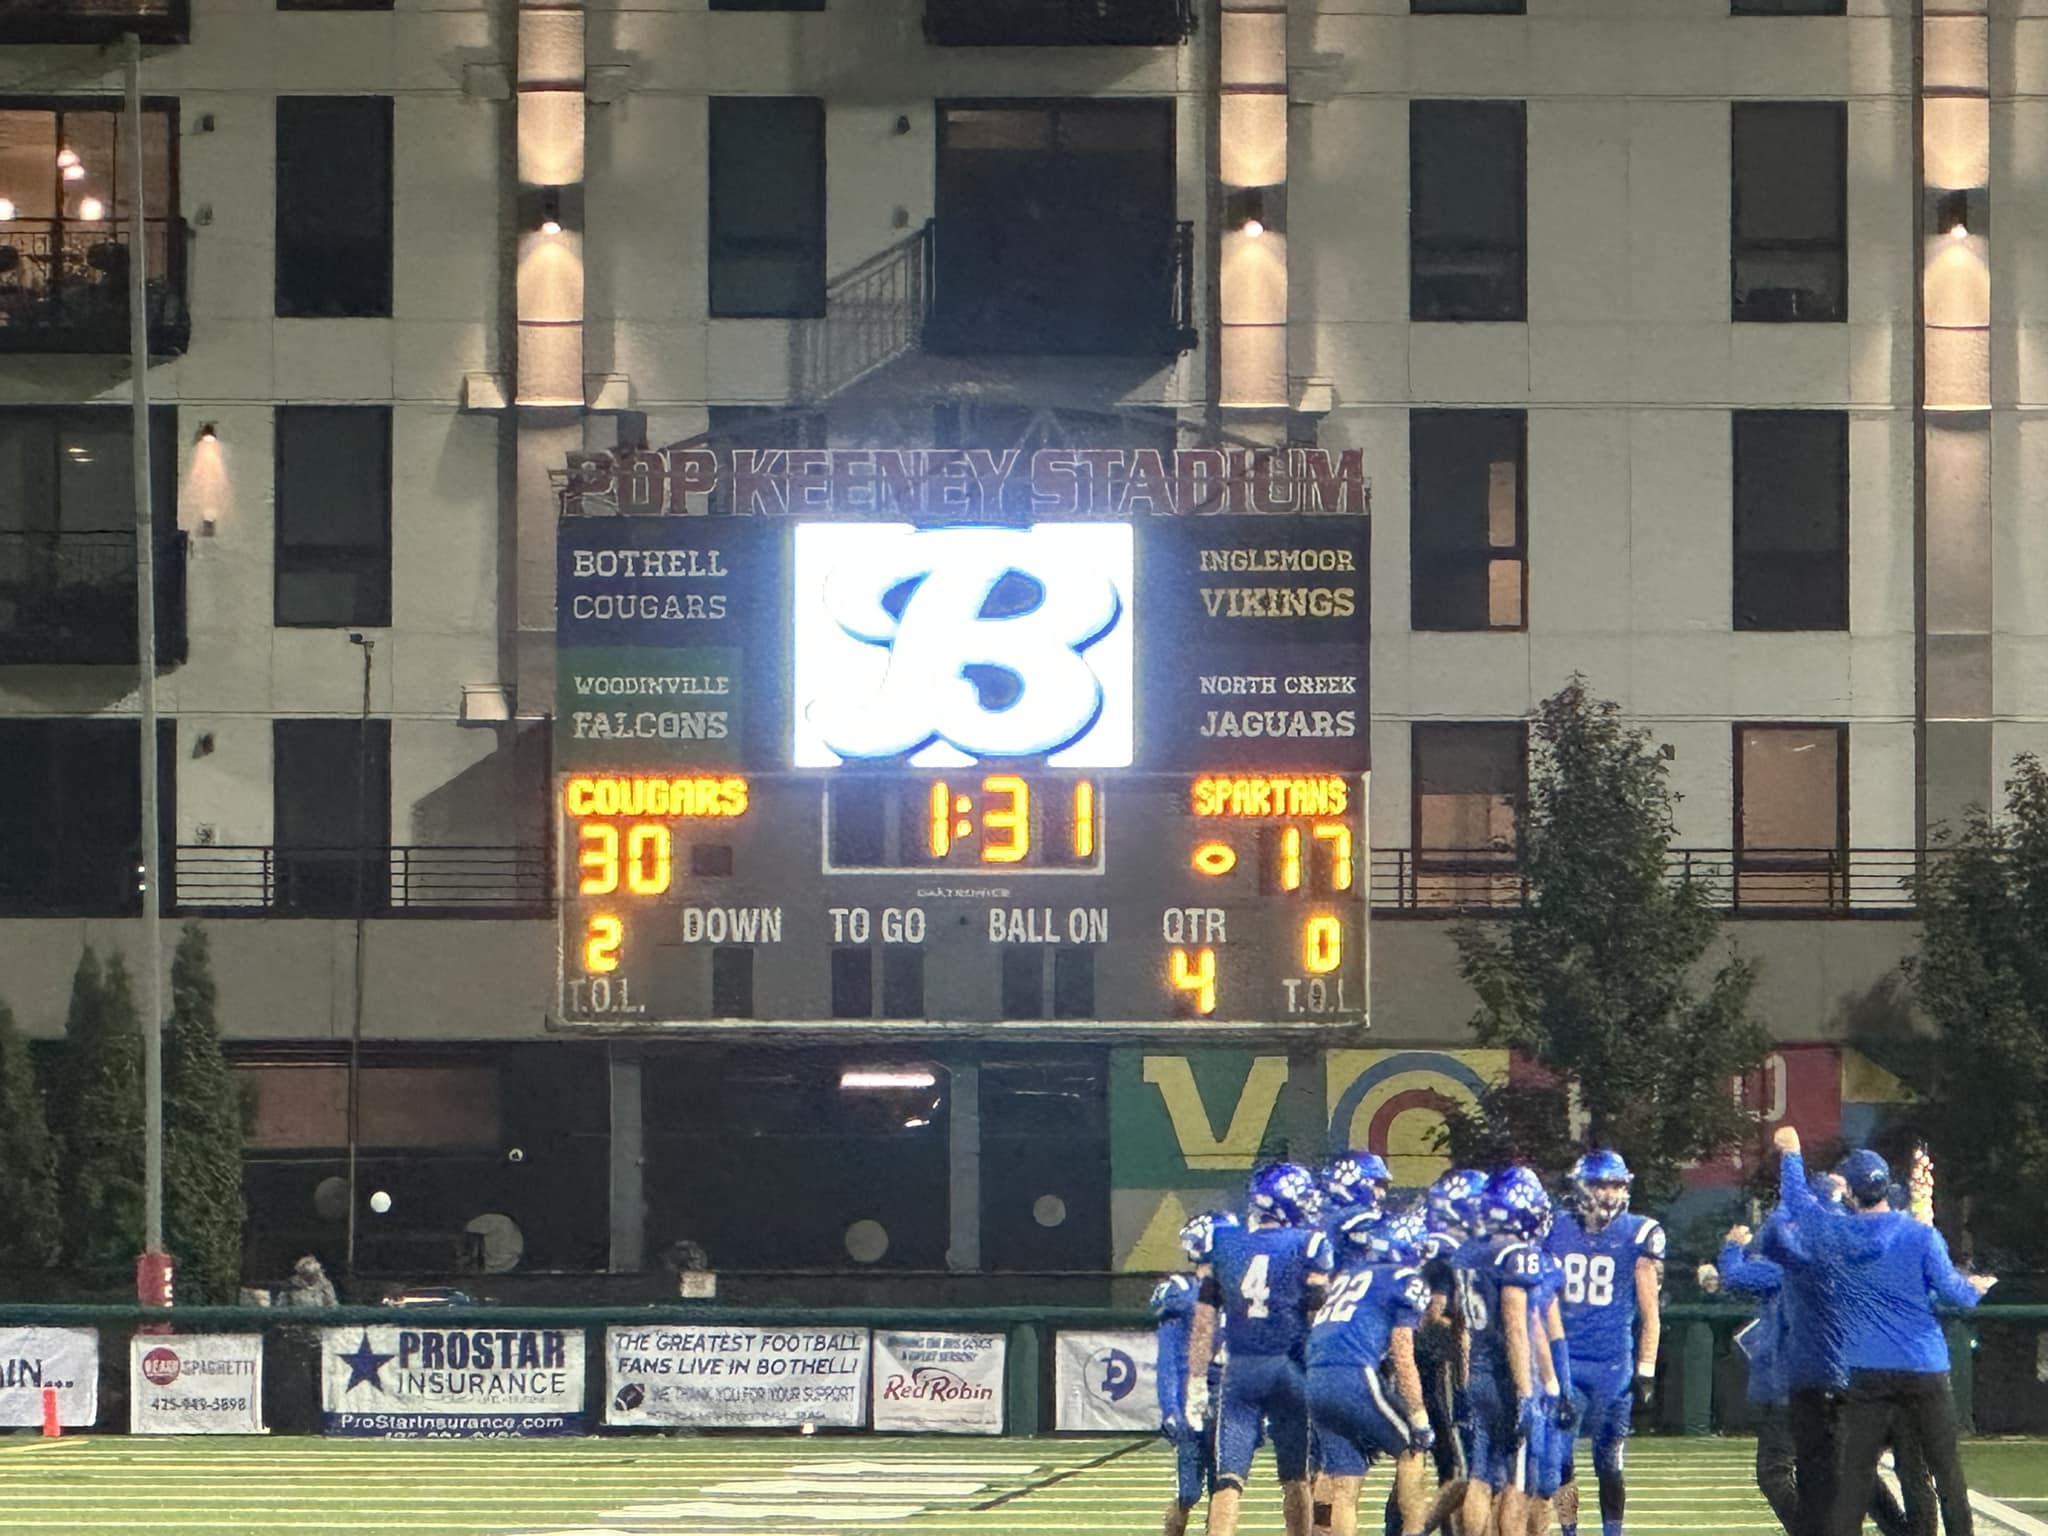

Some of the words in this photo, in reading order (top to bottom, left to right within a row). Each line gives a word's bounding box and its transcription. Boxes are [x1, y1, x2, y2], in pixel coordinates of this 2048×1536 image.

[563, 449, 719, 516] POP
[731, 448, 1020, 516] KEENEY
[1030, 447, 1368, 516] STADIUM
[573, 550, 728, 577] BOTHELL
[1200, 550, 1355, 571] INGLEMOOR
[573, 595, 727, 620] COUGARS
[1200, 588, 1355, 617] VIKINGS
[574, 676, 729, 694] WOODINVILLE
[1200, 676, 1277, 694] NORTH
[1284, 676, 1357, 694] CREEK
[573, 711, 728, 739] FALCONS
[1200, 711, 1355, 738] JAGUARS
[566, 778, 748, 817] COUGARS
[1192, 777, 1349, 816] SPARTANS
[928, 775, 1094, 864] 1:31
[578, 824, 672, 895] 30
[1280, 823, 1353, 891] 17
[683, 908, 782, 943] DOWN
[828, 908, 870, 943] TO
[881, 908, 926, 943] GO
[988, 908, 1060, 943] BALL
[1069, 908, 1108, 943] ON
[1162, 908, 1227, 943] QTR
[584, 914, 624, 973] 2
[1304, 914, 1342, 974] 0
[1168, 948, 1216, 1014] 4
[1239, 1253, 1270, 1318] 4
[1564, 1252, 1616, 1306] 88
[1312, 1270, 1373, 1326] 22
[400, 1331, 565, 1369] PROSTAR
[615, 1333, 650, 1351] THE
[656, 1332, 755, 1351] GREATEST
[760, 1334, 861, 1351] FOOTBALL
[398, 1372, 566, 1394] INSURANCE
[616, 1358, 672, 1374] FANS
[678, 1358, 726, 1374] LIVE
[729, 1359, 751, 1375] IN
[929, 1376, 993, 1402] Robin
